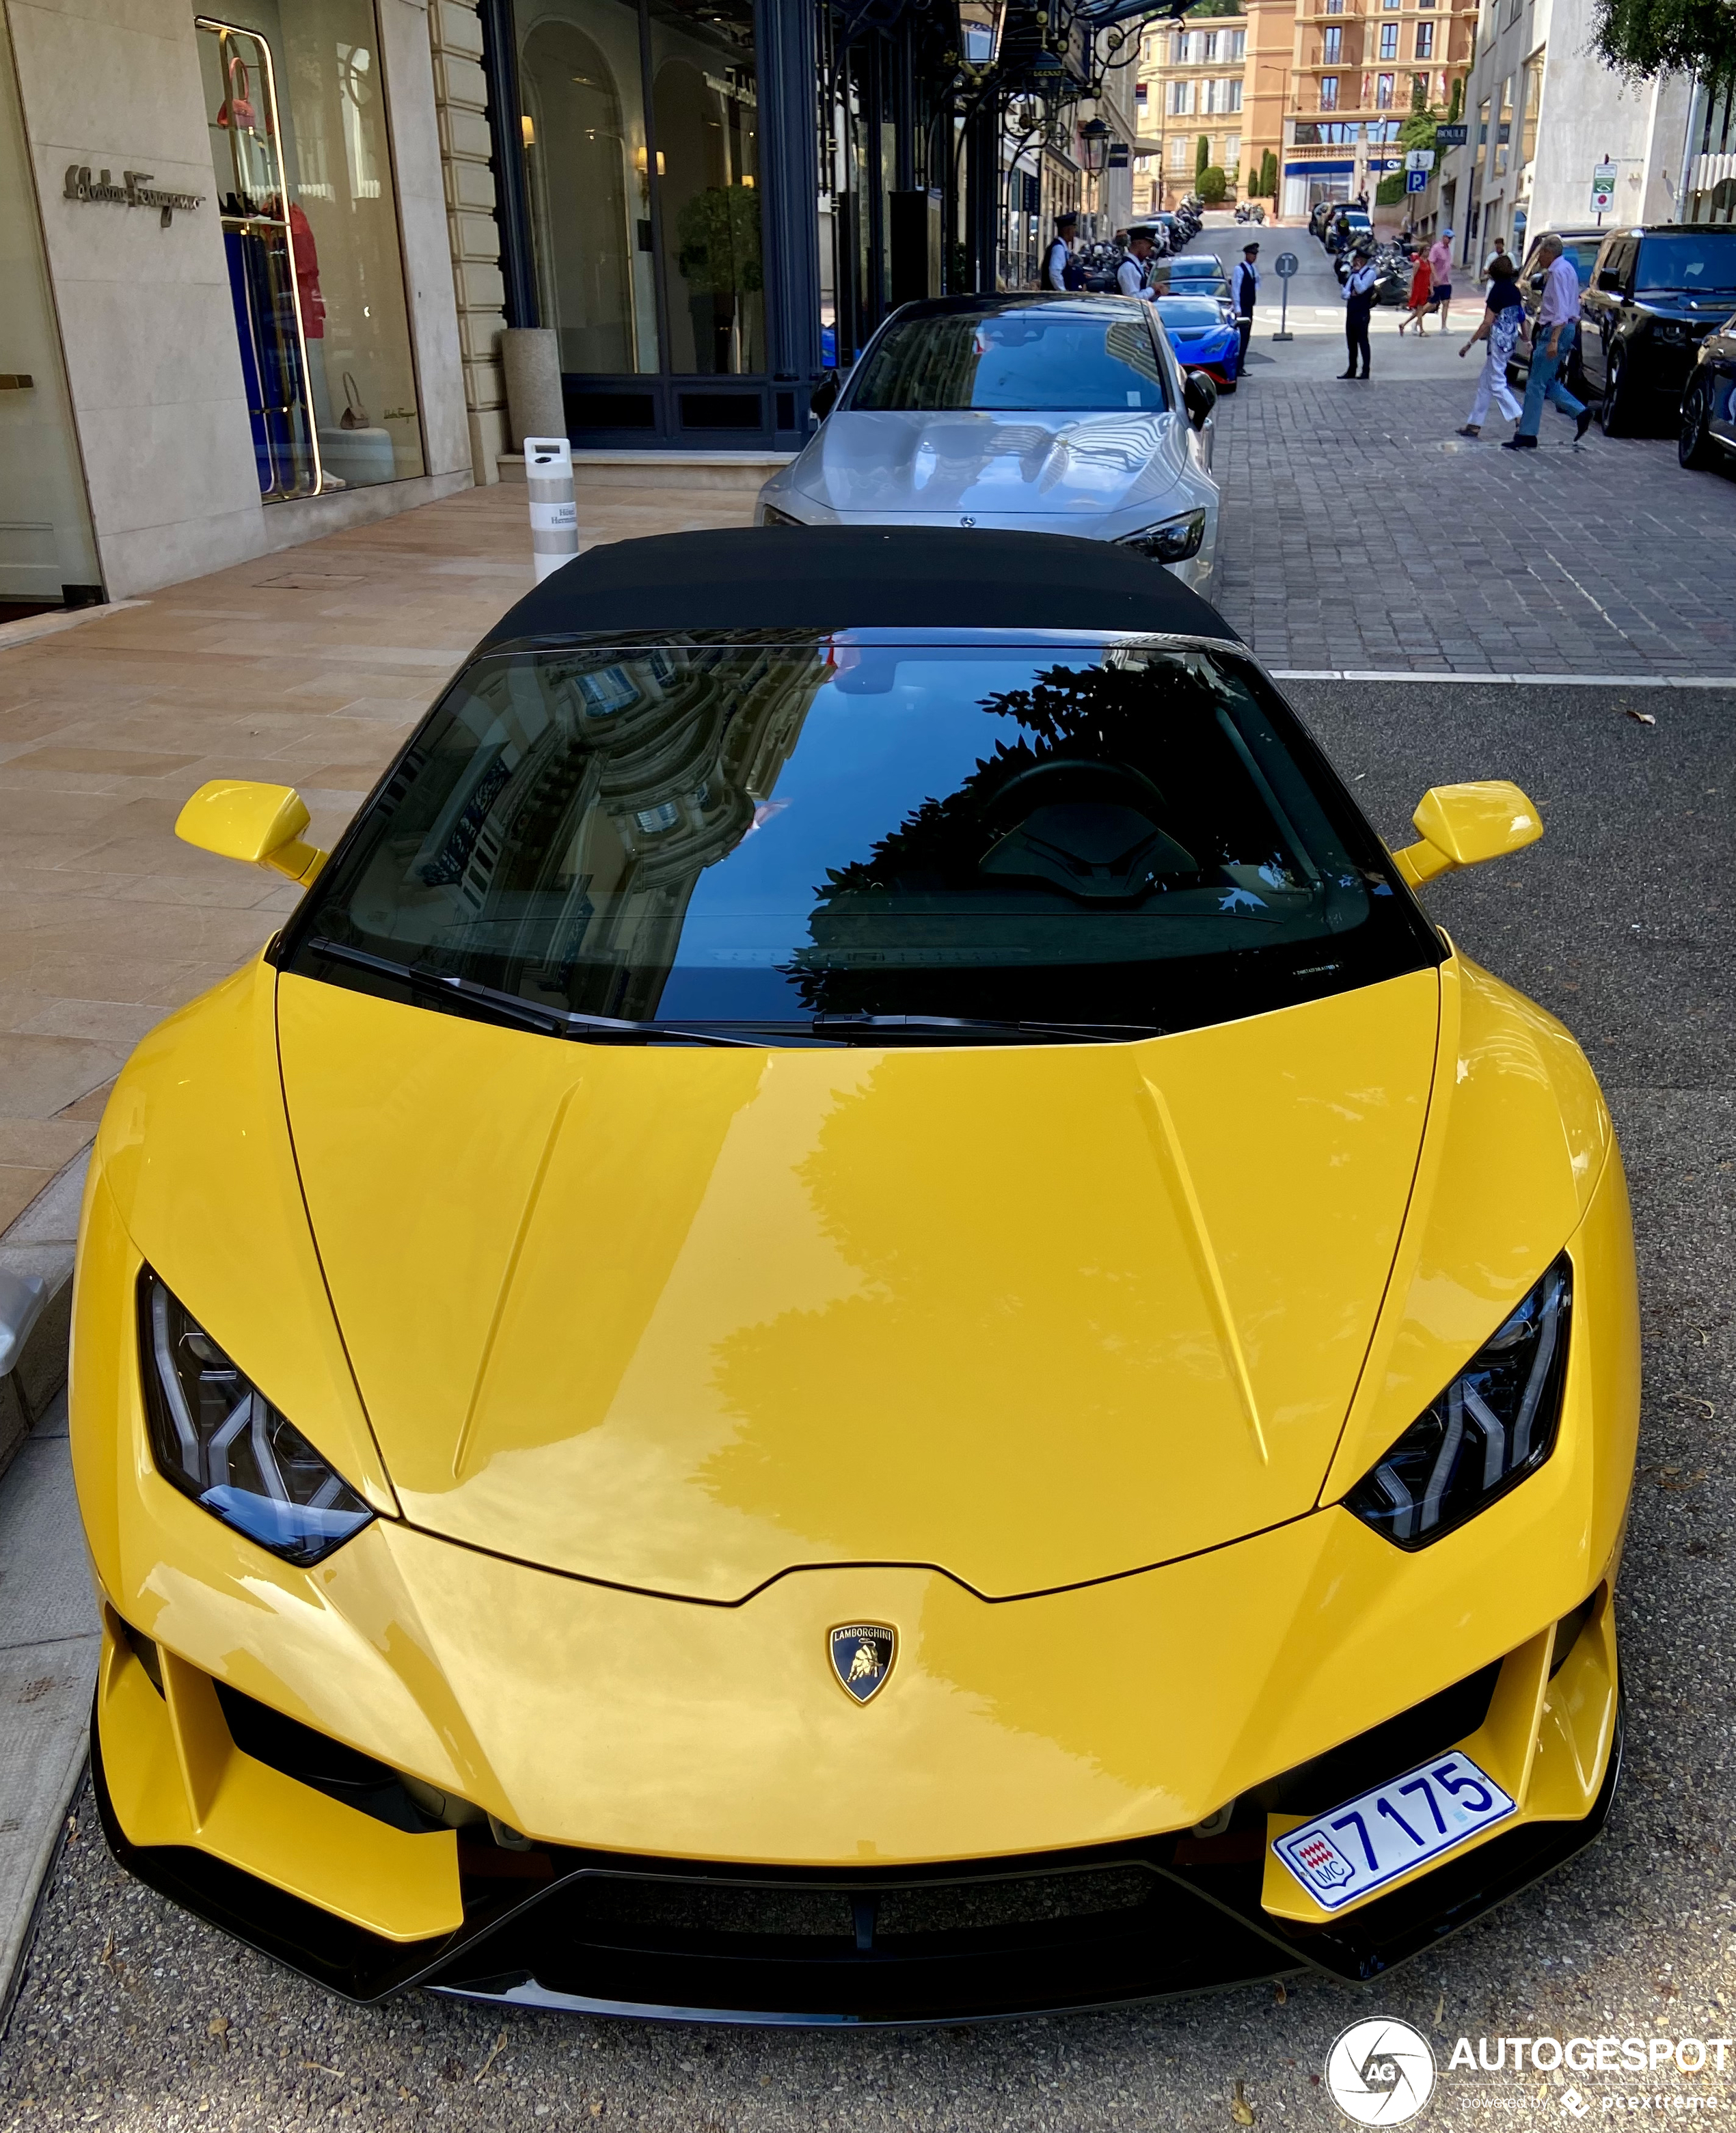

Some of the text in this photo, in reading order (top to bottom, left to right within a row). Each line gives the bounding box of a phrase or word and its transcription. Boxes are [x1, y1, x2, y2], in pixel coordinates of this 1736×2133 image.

[1412, 174, 1422, 189] P
[835, 1627, 891, 1641] LAMBORGHINI
[1330, 1762, 1493, 1872] 7175
[1315, 1860, 1345, 1884] MC
